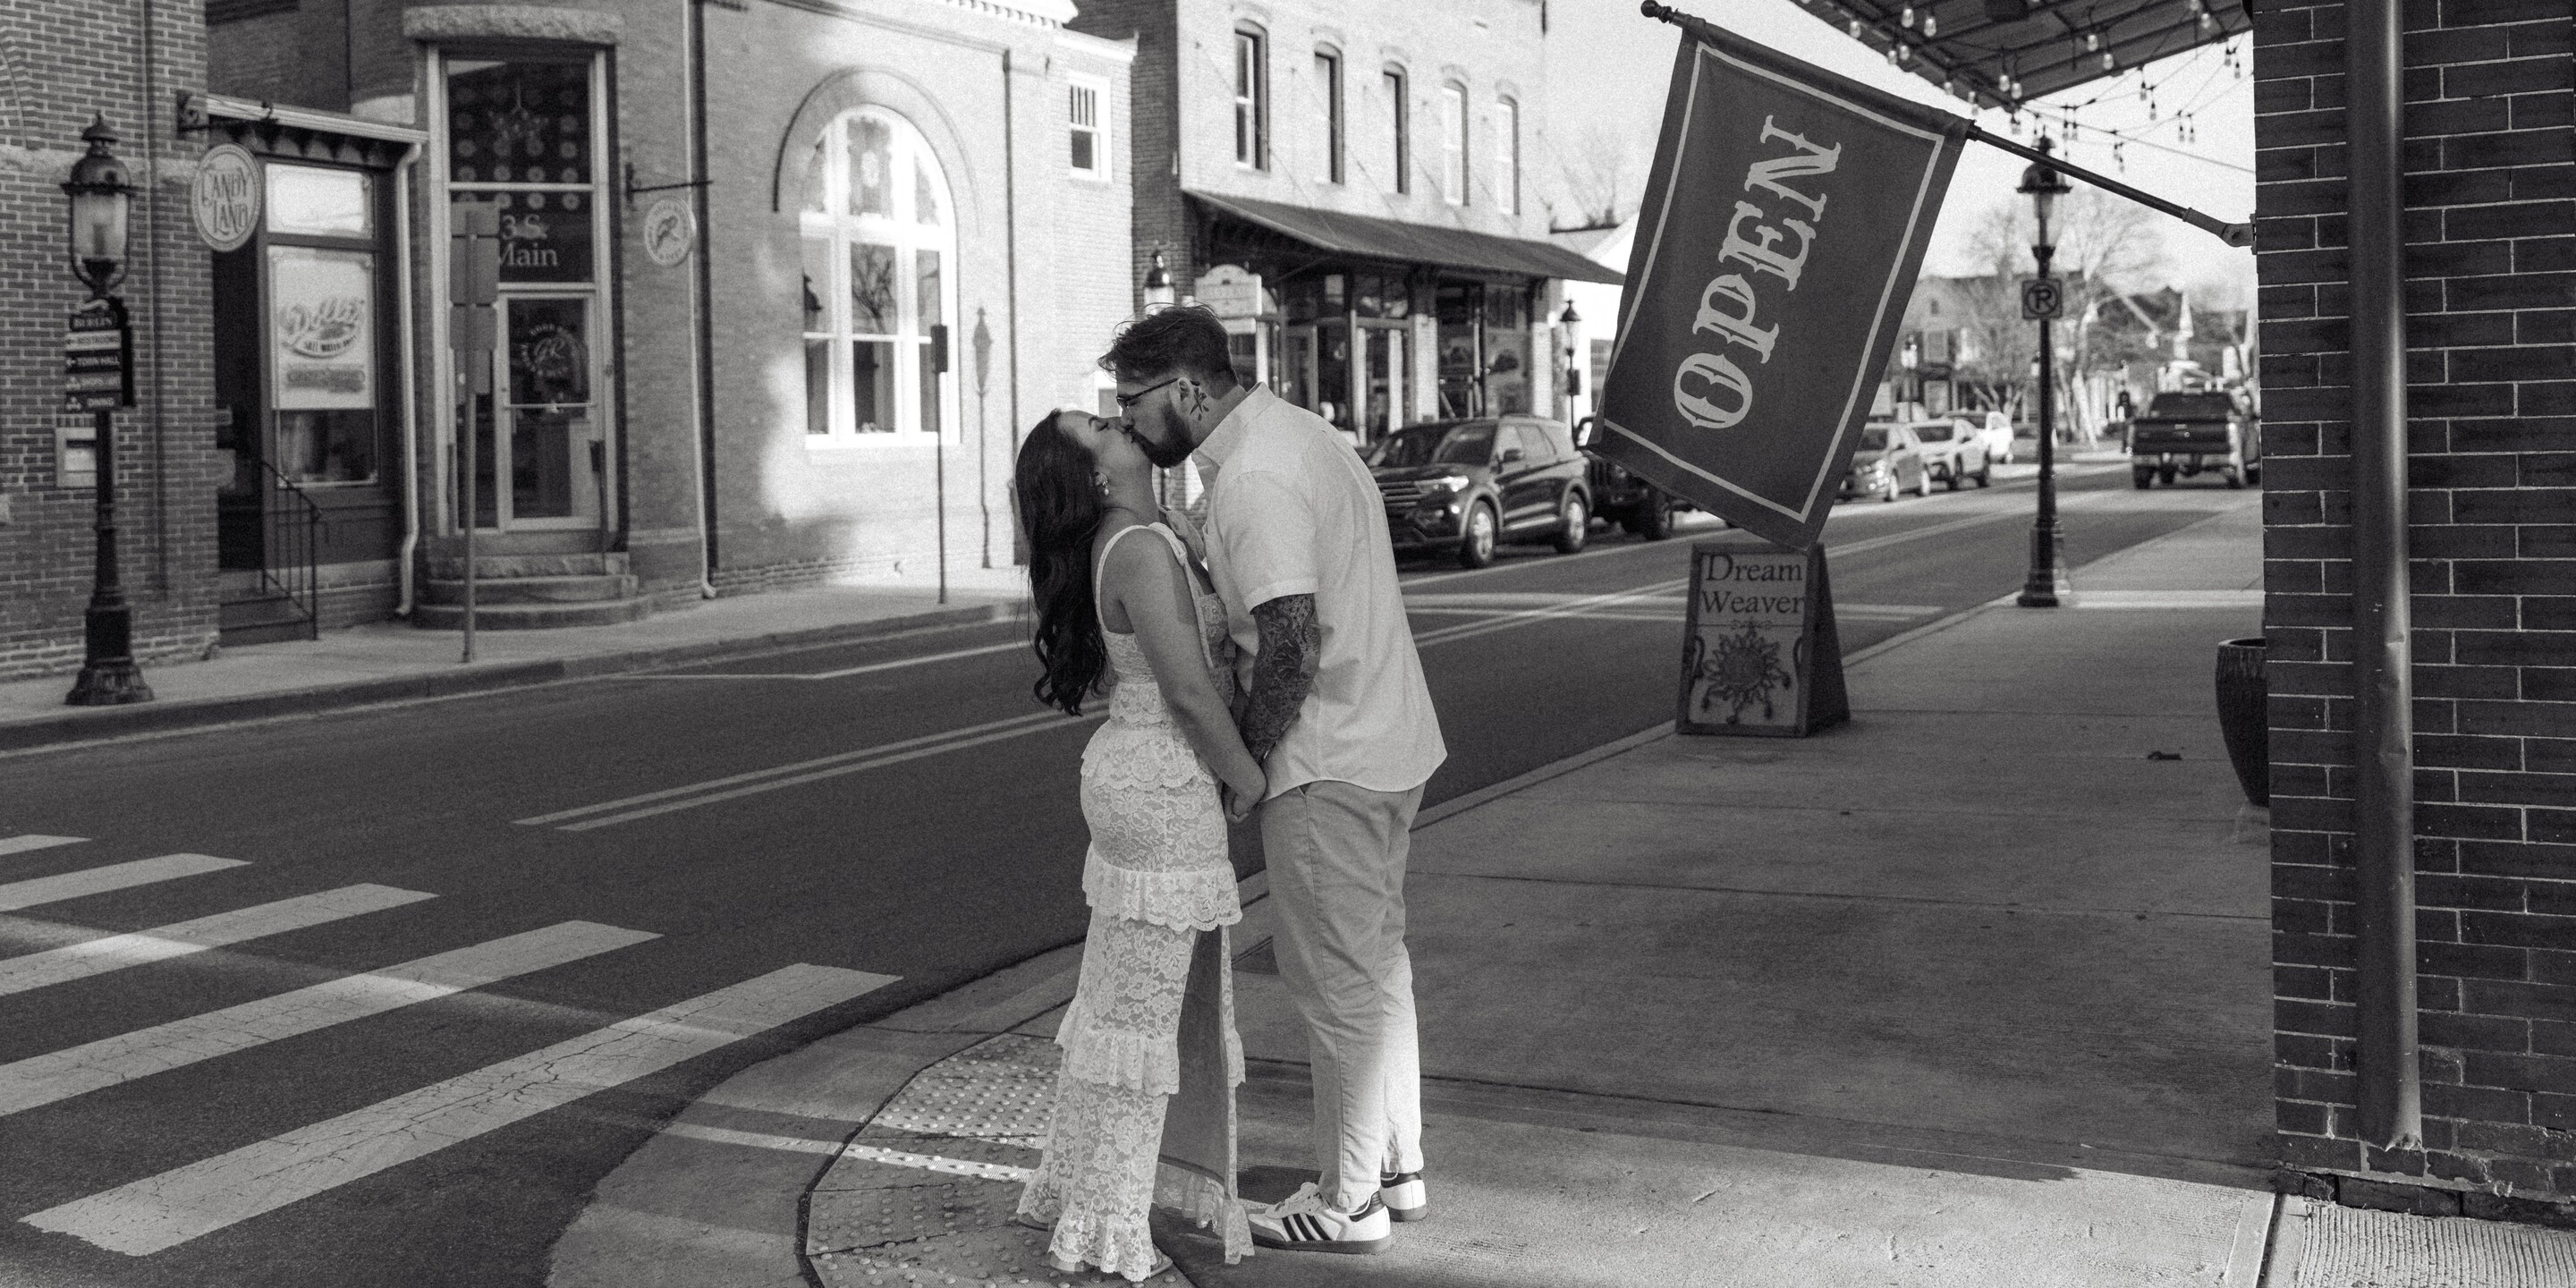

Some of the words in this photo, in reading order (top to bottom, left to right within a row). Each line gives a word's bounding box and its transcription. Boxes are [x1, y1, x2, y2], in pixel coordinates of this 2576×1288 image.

[202, 165, 246, 207] CANDY
[215, 199, 248, 235] LAND
[502, 215, 518, 240] 3
[1674, 114, 1841, 428] OPEN
[77, 357, 99, 367] TOWN
[100, 356, 120, 366] HALL
[87, 397, 114, 408] DINING
[1705, 553, 1803, 582] Dream
[1702, 590, 1806, 614] Weaver
